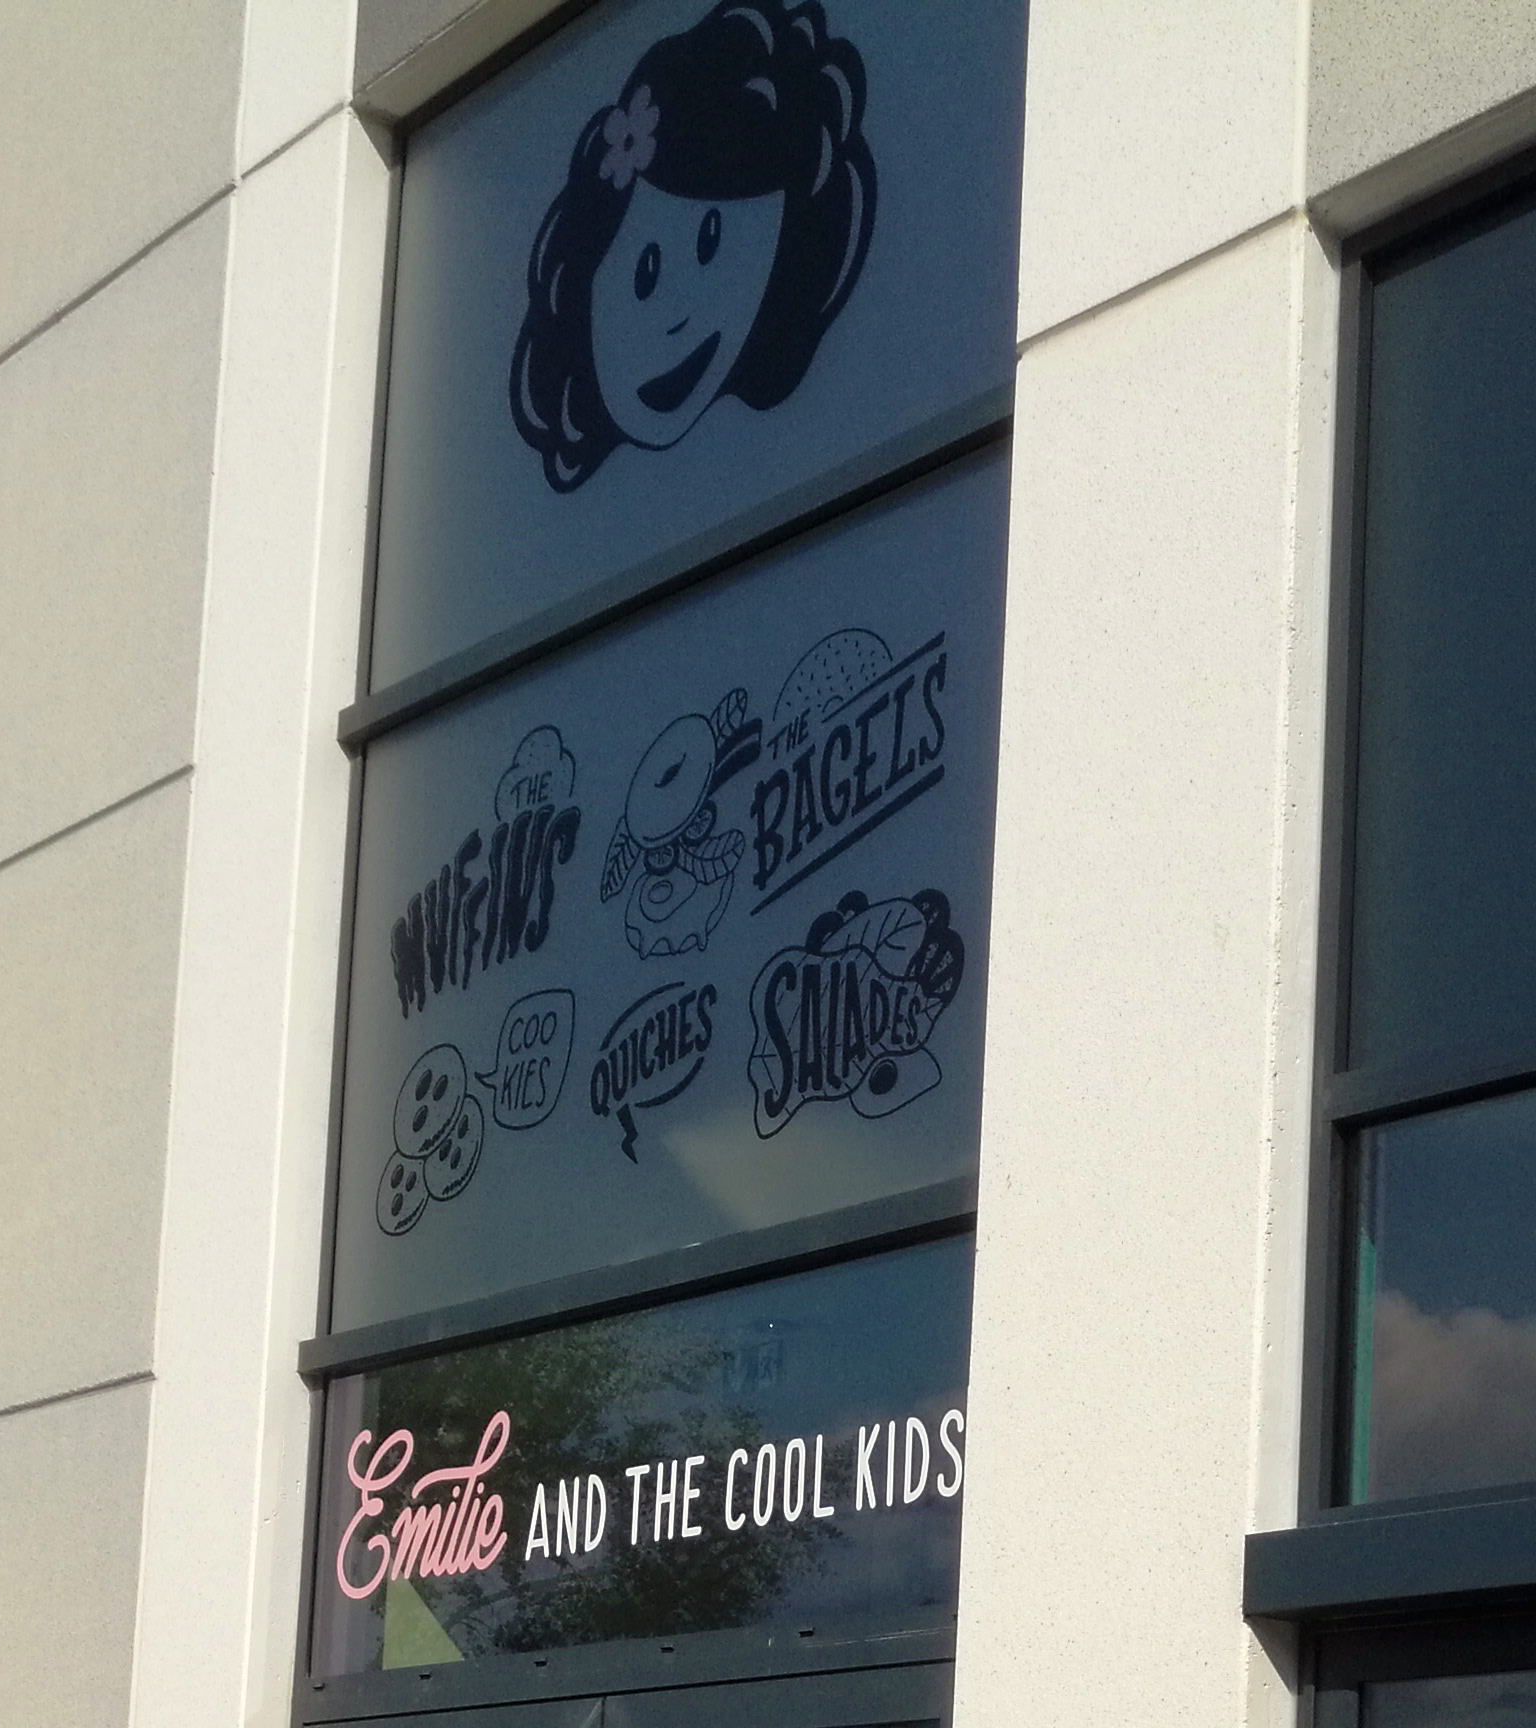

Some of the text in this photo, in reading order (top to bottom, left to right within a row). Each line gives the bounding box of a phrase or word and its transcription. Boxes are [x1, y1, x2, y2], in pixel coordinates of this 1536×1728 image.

[750, 652, 947, 891] BAGELS
[767, 707, 811, 760] THE
[510, 770, 553, 808] THE
[509, 1011, 557, 1054] COO
[590, 983, 717, 1117] QUICHES
[764, 961, 921, 1118] SALADES
[501, 1056, 551, 1110] KIES
[336, 1408, 964, 1600] Emilie AND THE COOL KIDS
